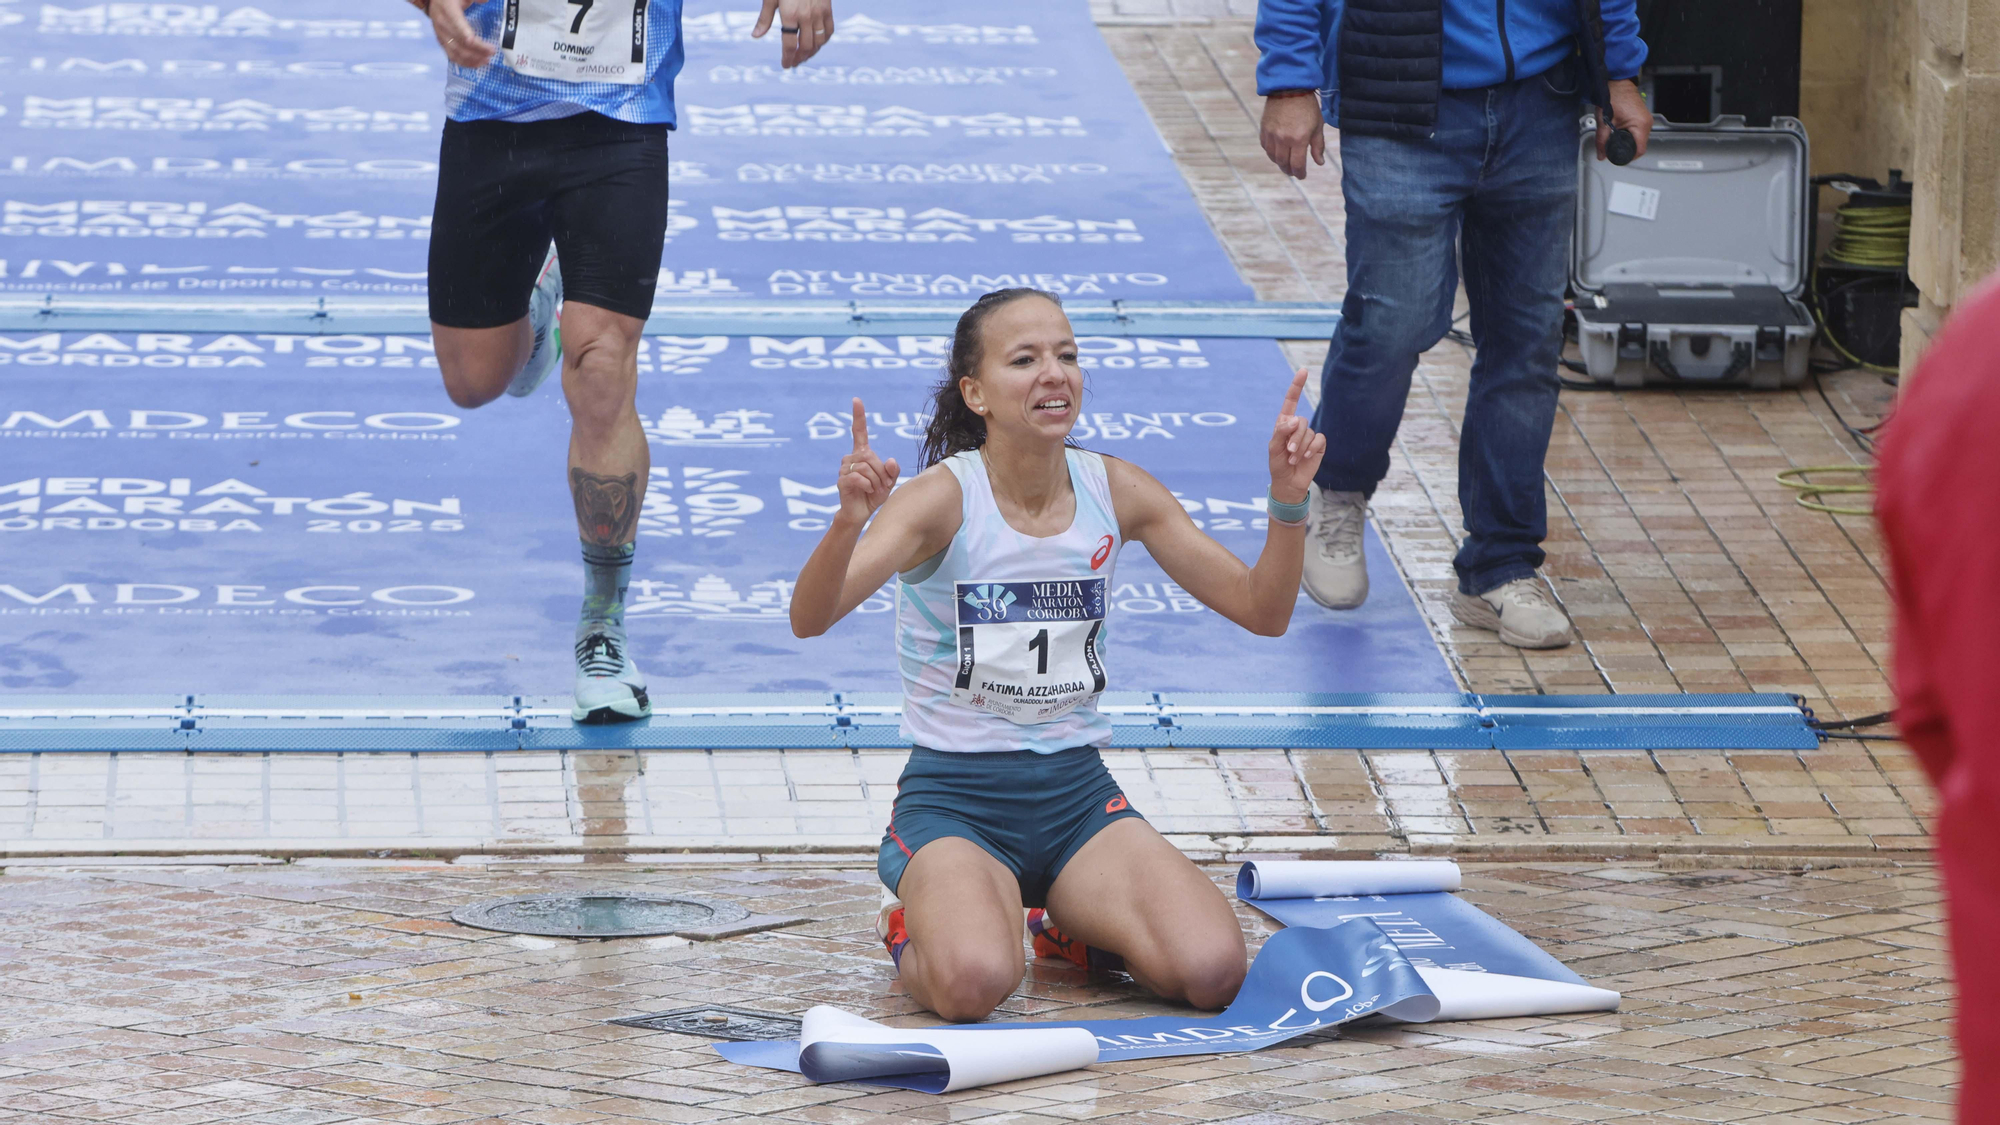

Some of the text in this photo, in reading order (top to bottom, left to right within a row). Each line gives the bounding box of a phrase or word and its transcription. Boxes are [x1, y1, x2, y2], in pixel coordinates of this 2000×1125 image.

[568, 0, 593, 34] 7
[553, 41, 595, 56] DOMINGO
[585, 65, 625, 75] IMDECO
[24, 96, 272, 111] MEDIA
[685, 104, 926, 117] MEDIA
[11, 156, 438, 173] IMDECO
[4, 200, 272, 216] MEDIA
[712, 205, 972, 220] MEDIA
[4, 211, 433, 229] MARATÓN
[717, 215, 1138, 232] MARATÓN
[1011, 232, 1146, 244] 2025
[321, 278, 428, 293] Córdob
[768, 269, 1169, 287] AYUNTAMIENTO
[770, 281, 835, 296] DE
[750, 354, 1211, 370] CÓRDO 2025
[1, 410, 461, 430] MDECO
[0, 430, 107, 440] nicipal
[0, 514, 465, 533] ÓRDOBA 2025
[0, 583, 475, 605] MDECO
[1032, 582, 1083, 598] MEDIA
[975, 598, 1007, 621] 39
[1031, 595, 1084, 608] MARATÓN
[1027, 606, 1088, 619] CÓRDOBA
[1029, 629, 1048, 674] 1
[1086, 645, 1101, 675] CAJÓN
[982, 681, 1085, 697] FÁTIMA AZZAHARAA
[1094, 970, 1354, 1046] IMDECO
